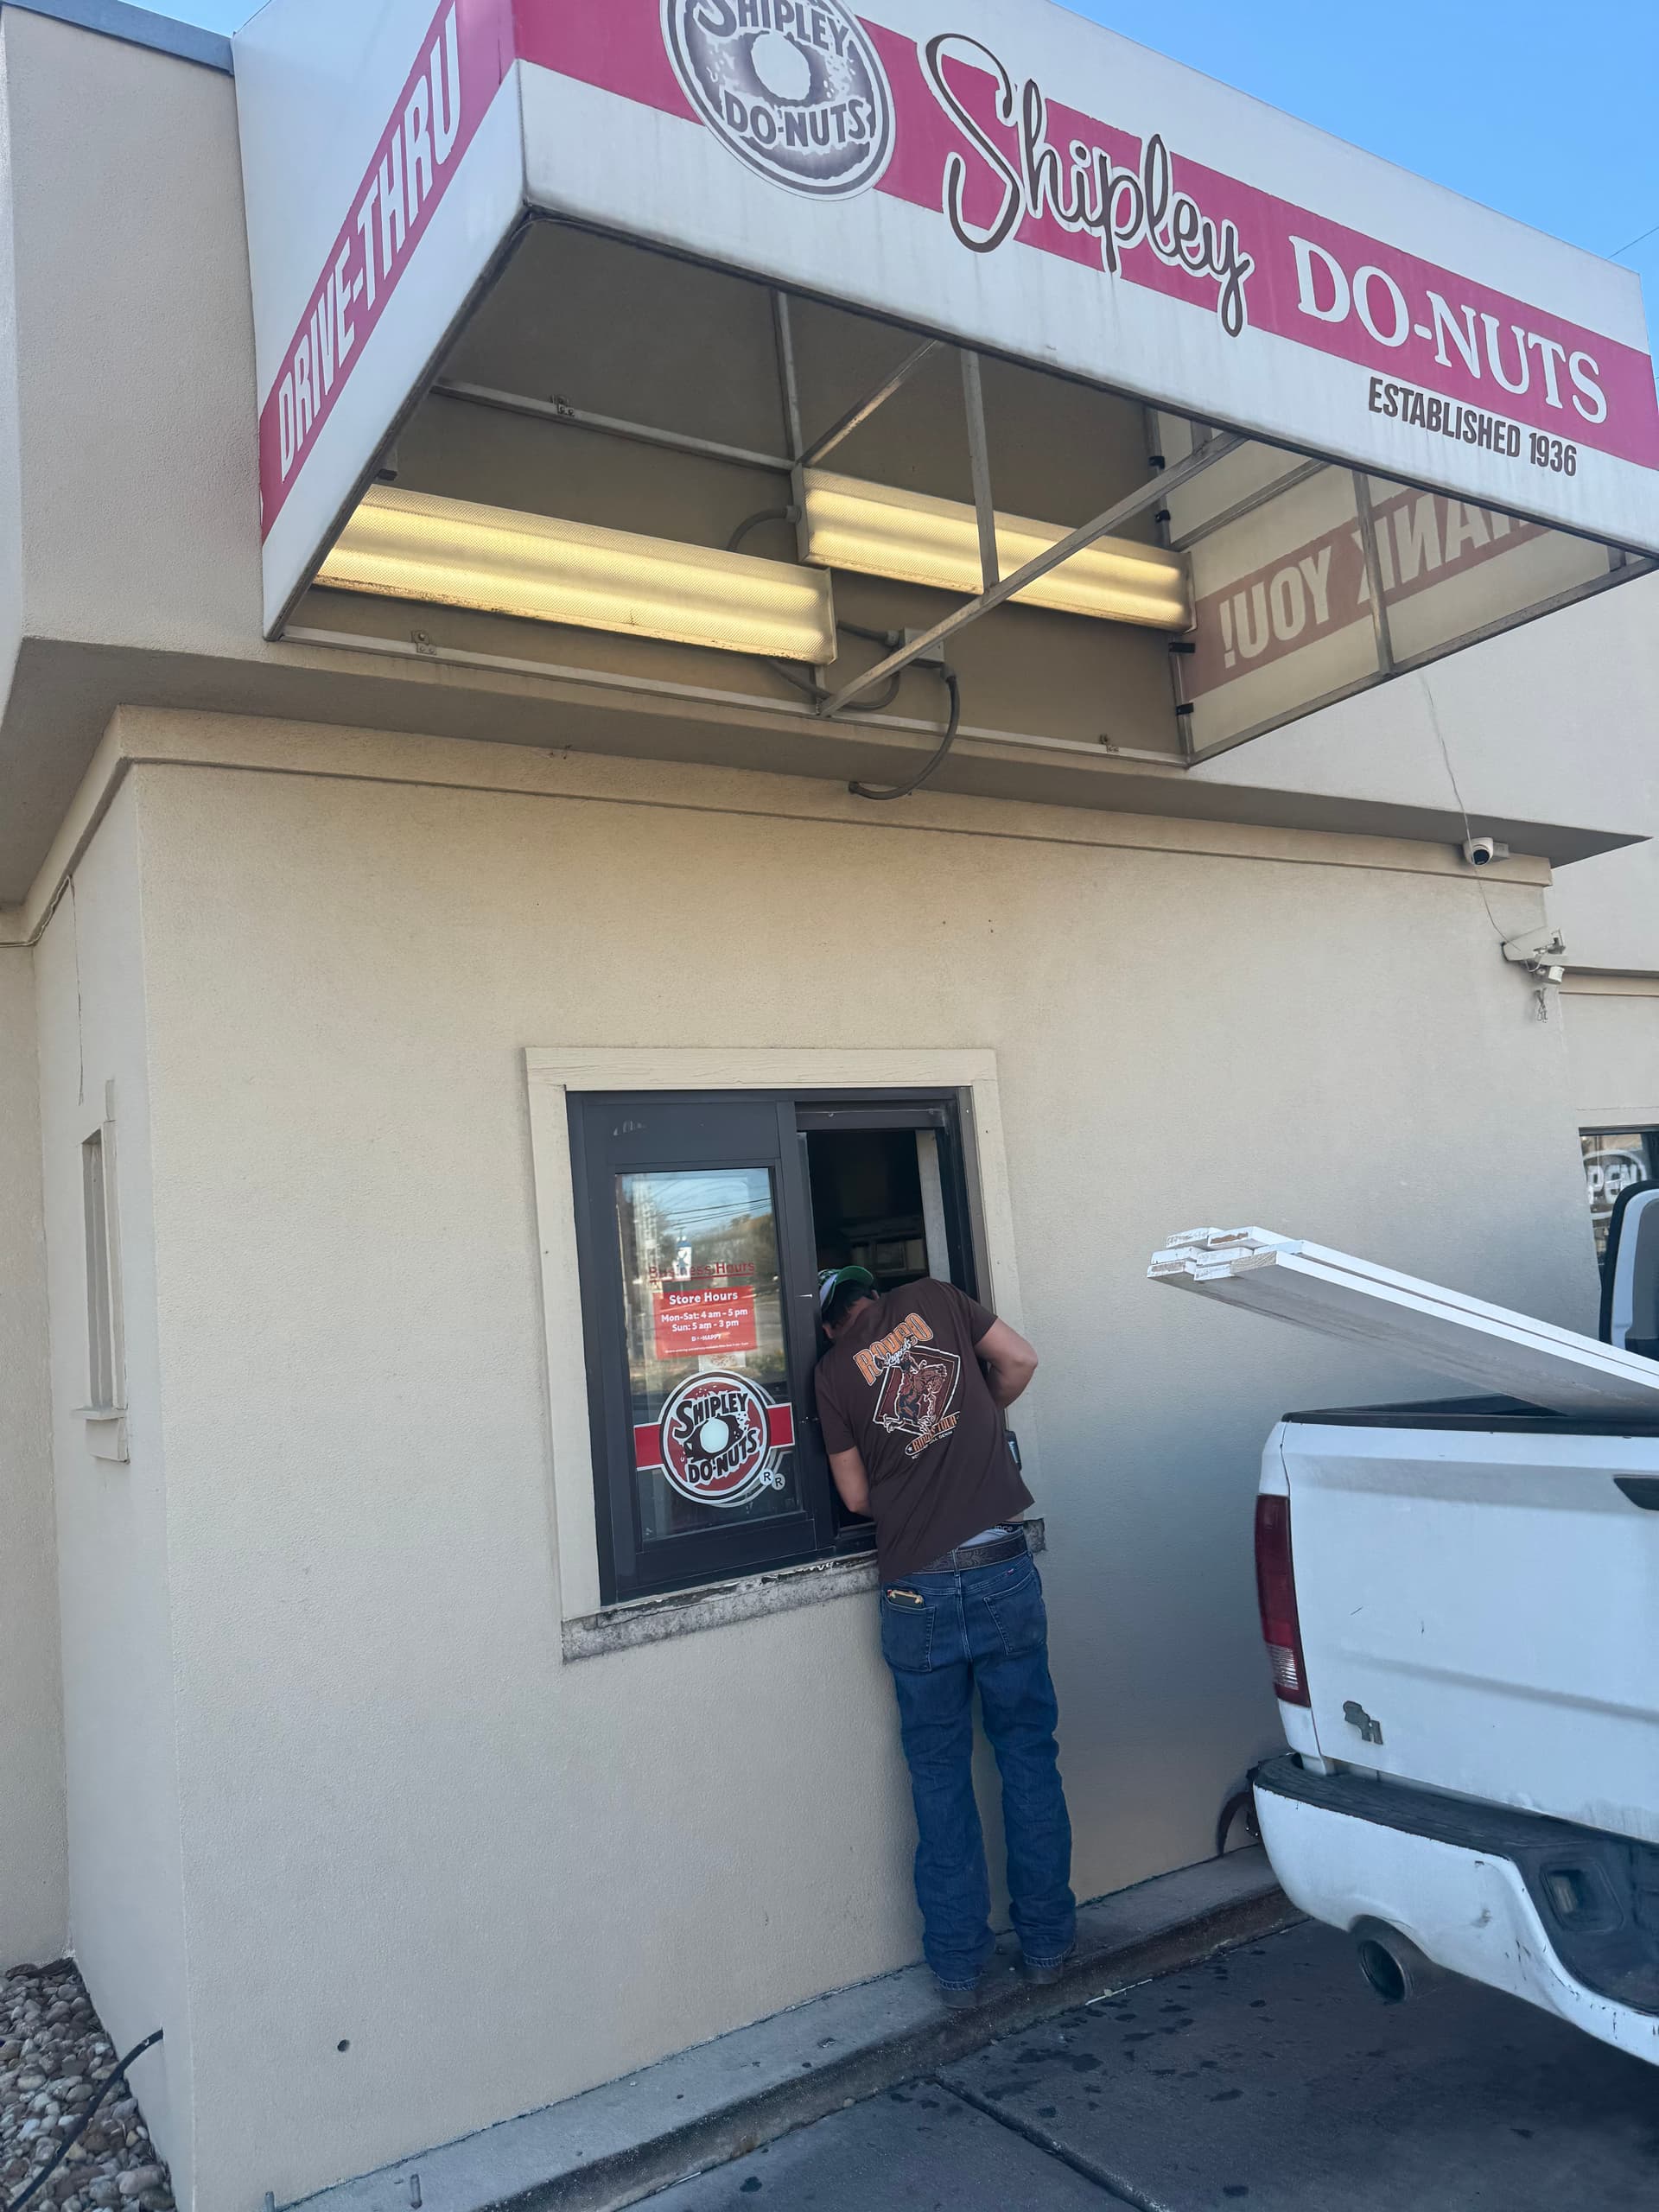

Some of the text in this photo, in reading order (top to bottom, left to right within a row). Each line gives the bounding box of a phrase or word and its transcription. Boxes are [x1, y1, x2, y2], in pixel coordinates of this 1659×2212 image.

[696, 0, 849, 57] SHIPLEY
[724, 90, 866, 148] DO-NUTS
[277, 3, 461, 484] DRIVE-THRU
[925, 33, 1609, 424] Shipley DO-NUTS
[1368, 375, 1578, 477] ESTABLISHED 1936
[649, 1262, 755, 1279] Busness Hours
[661, 1312, 700, 1322] Mon-Sat:
[669, 1292, 739, 1306] Store Hours
[672, 1323, 691, 1332] Sun:
[719, 1319, 724, 1328] 3
[726, 1320, 739, 1329] pm
[674, 1393, 748, 1439] SHIPLEY
[689, 1429, 757, 1484] DO-NUTS
